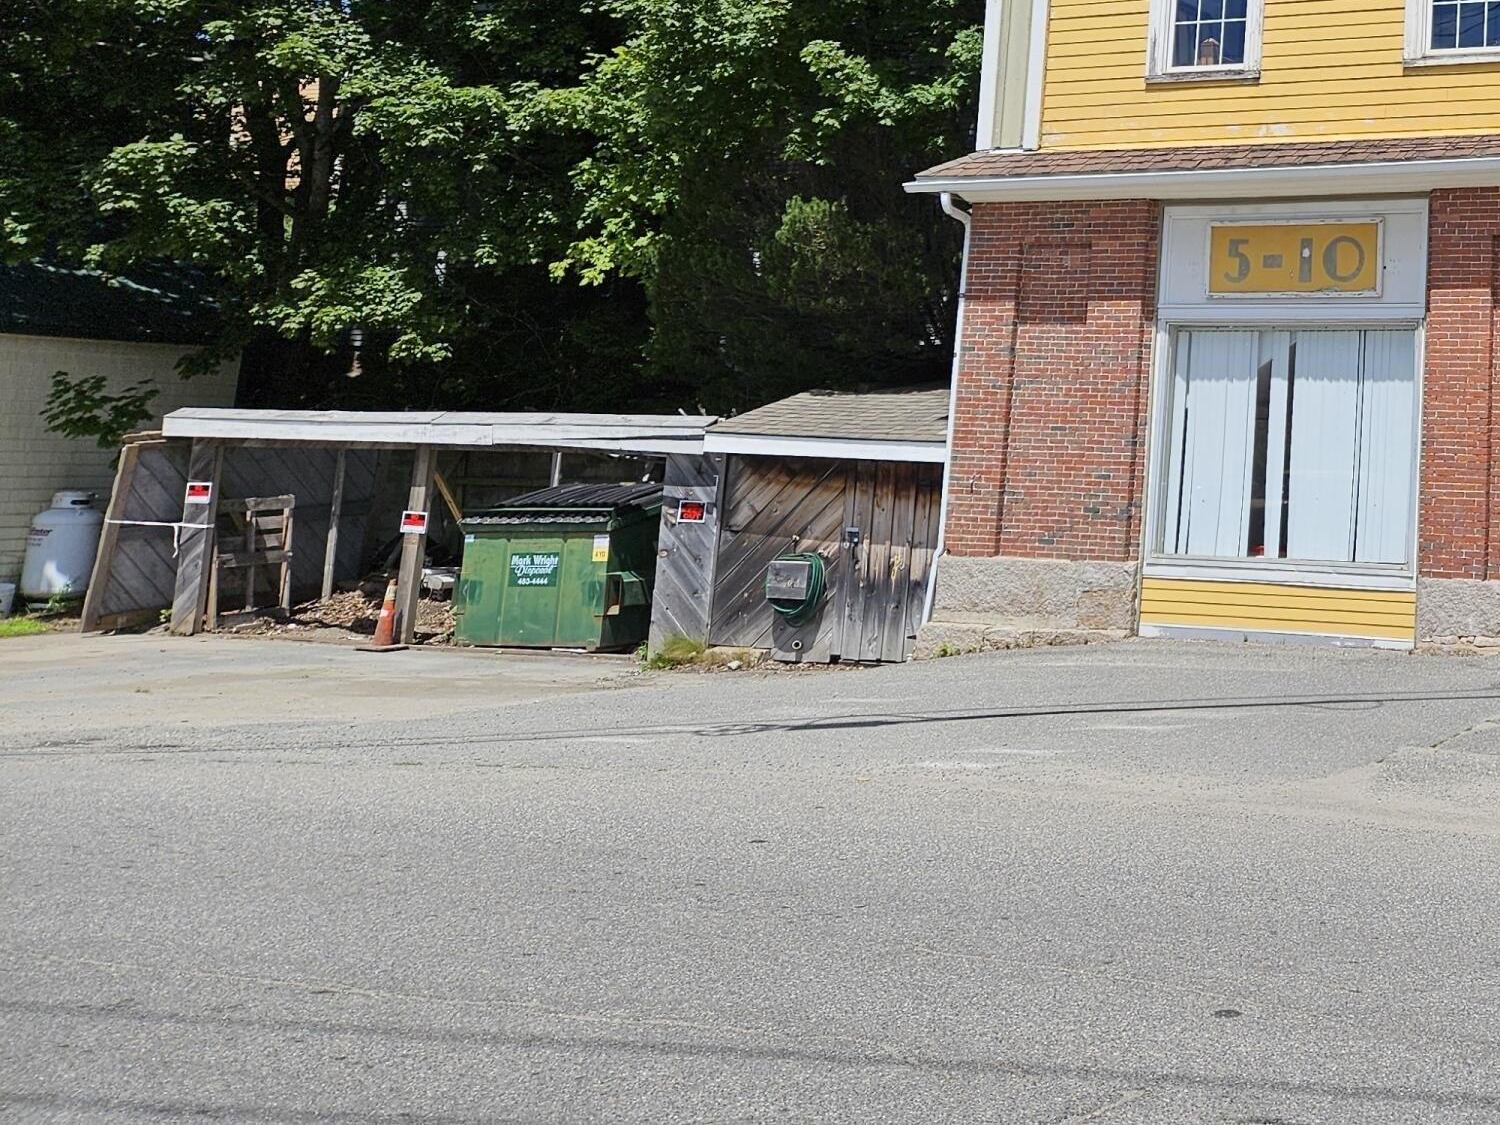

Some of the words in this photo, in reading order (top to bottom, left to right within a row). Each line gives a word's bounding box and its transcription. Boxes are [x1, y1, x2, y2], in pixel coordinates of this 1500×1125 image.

[1223, 235, 1366, 284] 5-10
[511, 554, 531, 566] Mark
[532, 554, 559, 567] Wright
